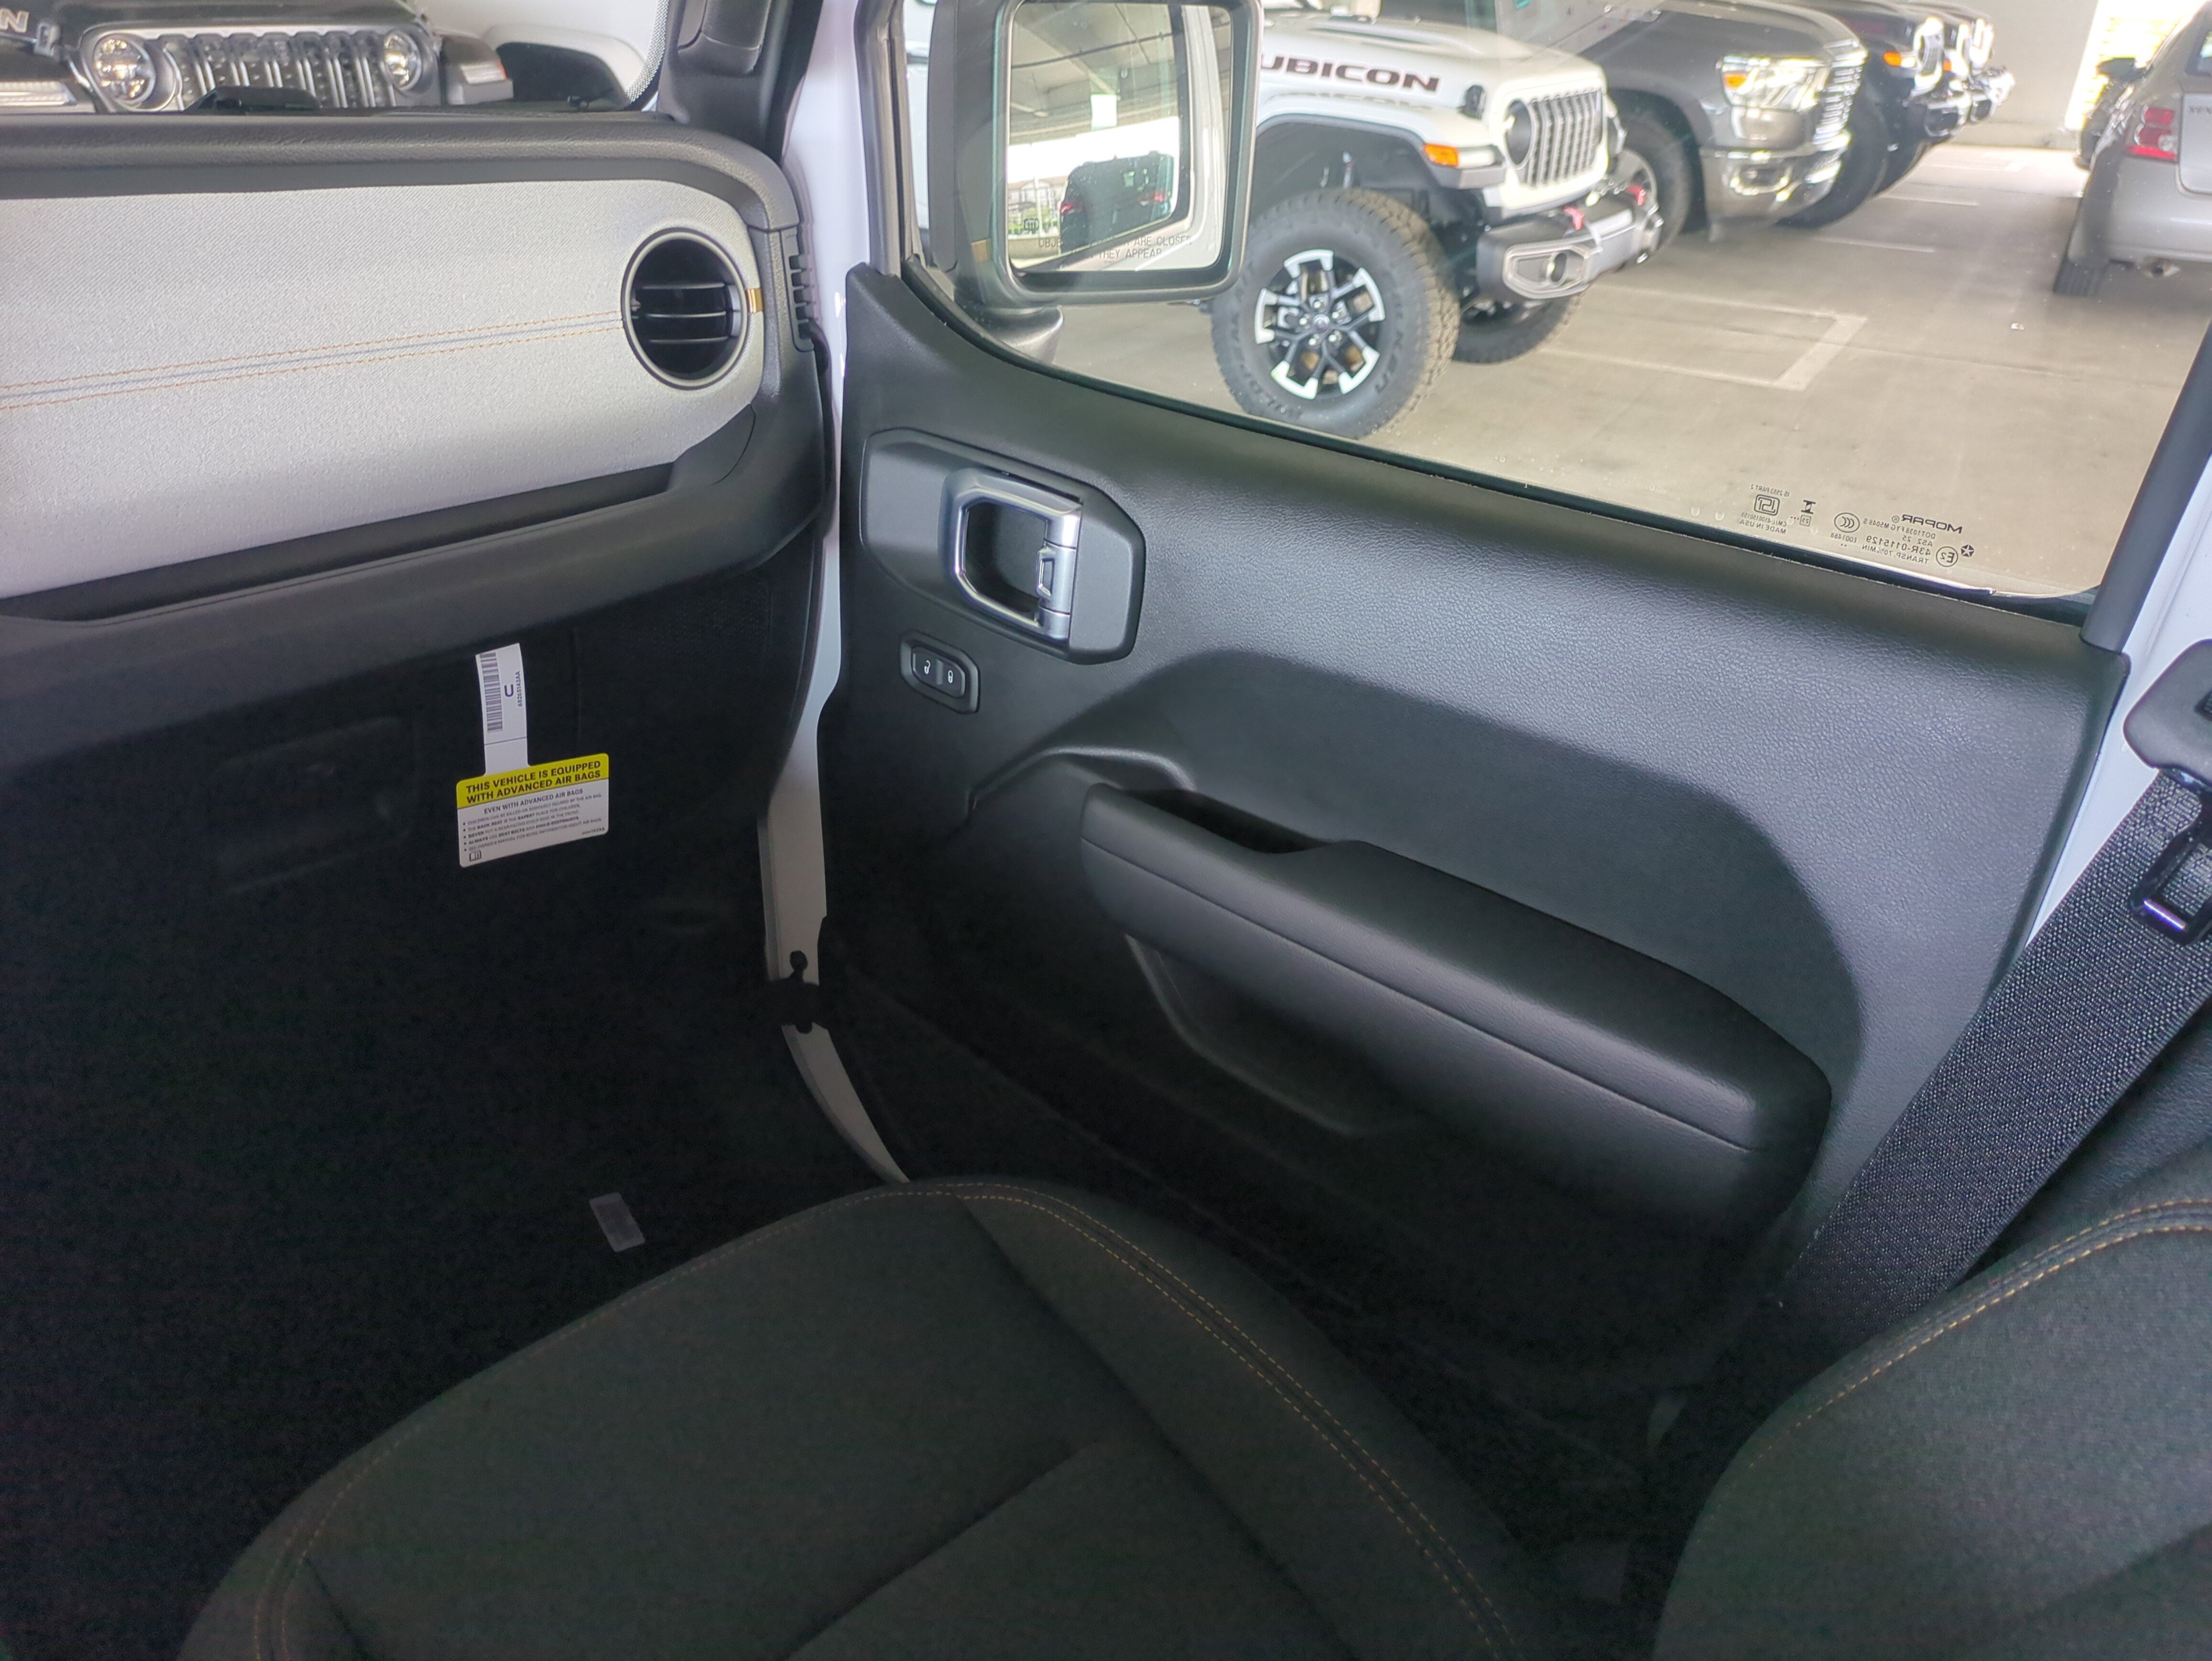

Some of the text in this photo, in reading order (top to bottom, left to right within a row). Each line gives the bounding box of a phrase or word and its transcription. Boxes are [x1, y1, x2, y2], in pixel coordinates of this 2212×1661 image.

[466, 760, 600, 793] THIS VEHICLE IS EQUIPPED
[466, 770, 600, 804] WITH ADVANCED AIR BAGS
[484, 806, 500, 814] EVEN
[502, 802, 519, 810] WITH
[520, 795, 553, 806] ADVANCED
[567, 788, 583, 797] BAGS
